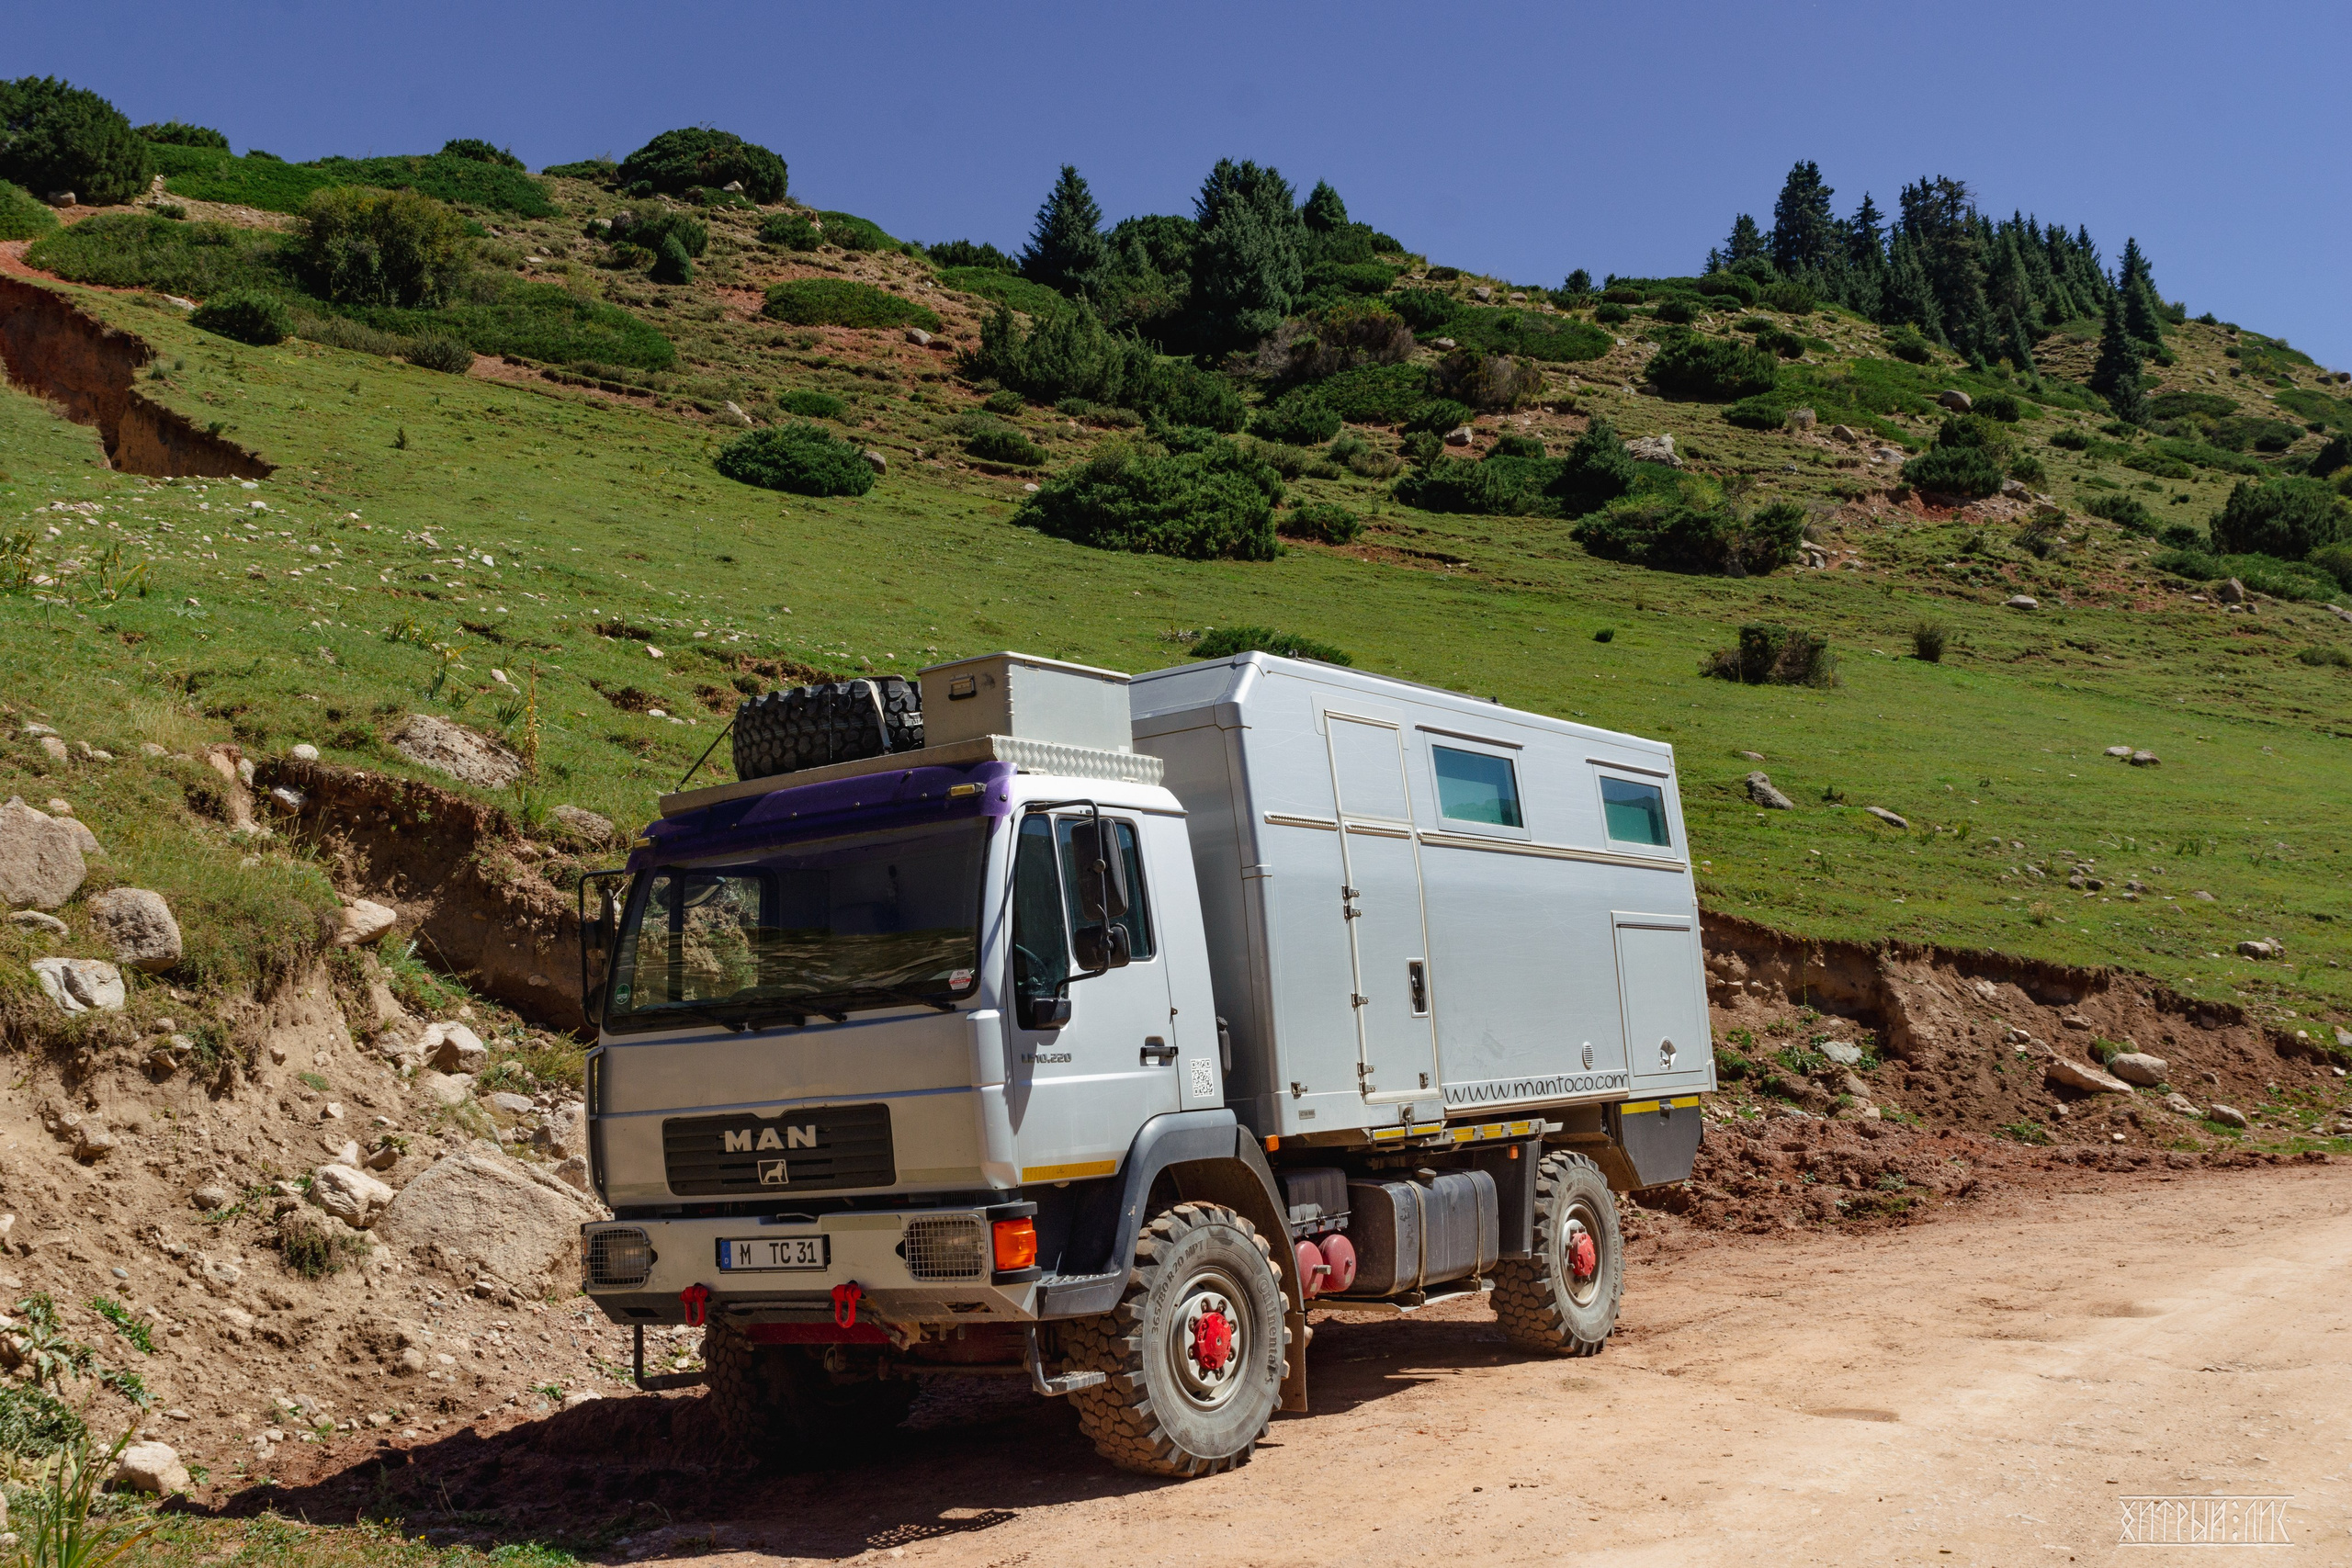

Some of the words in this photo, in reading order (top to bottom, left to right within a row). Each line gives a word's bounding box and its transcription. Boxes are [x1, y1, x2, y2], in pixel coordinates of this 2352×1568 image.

[1444, 1073, 1629, 1104] www.mantoco.com
[724, 1124, 817, 1153] MAN
[724, 1257, 729, 1265] D
[740, 1243, 752, 1265] M
[769, 1242, 791, 1264] TC
[797, 1241, 817, 1264] 31
[1151, 1281, 1170, 1336] 365/80
[1184, 1239, 1204, 1259] MPT
[1257, 1274, 1280, 1372] Continental
